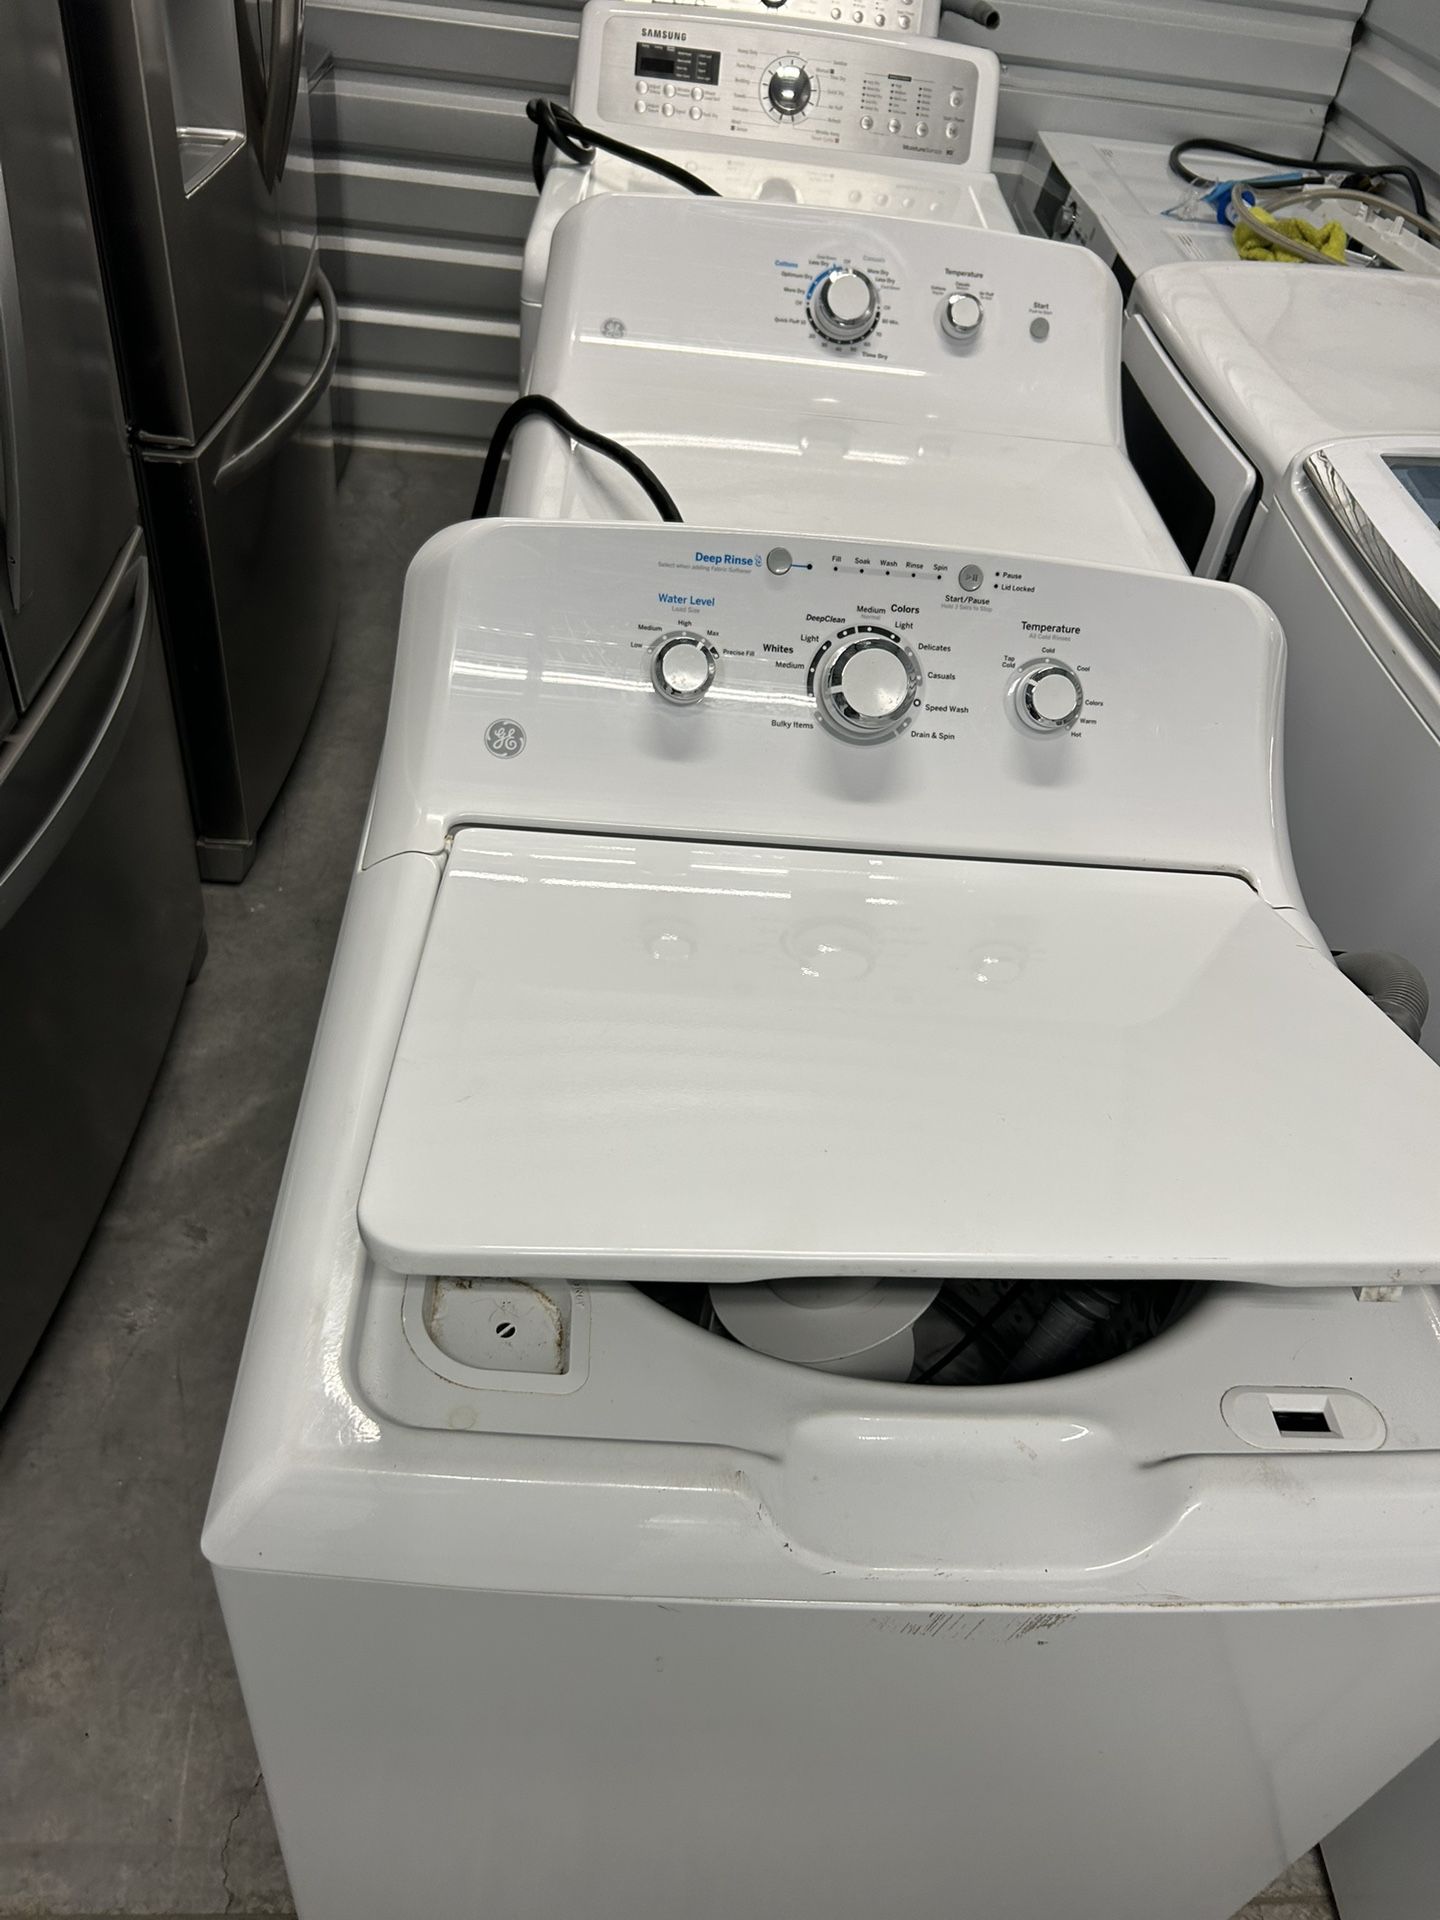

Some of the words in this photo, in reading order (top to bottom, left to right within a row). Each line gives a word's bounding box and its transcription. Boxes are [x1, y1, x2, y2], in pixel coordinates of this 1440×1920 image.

[641, 27, 687, 42] SAMSUNG
[774, 259, 799, 268] Cottons
[945, 267, 984, 279] Temperature
[1033, 301, 1050, 310] Start
[862, 351, 877, 359] Time
[877, 353, 889, 361] Dry
[695, 552, 722, 565] Deep
[724, 554, 754, 566] Rinse
[832, 555, 842, 563] Fill
[854, 557, 871, 565] Soak
[880, 559, 898, 568] Wash
[905, 562, 924, 570] Rinse
[933, 563, 948, 573] Spin
[1002, 572, 1022, 580] Pause
[1001, 583, 1012, 592] Lid
[1013, 584, 1035, 593] Locked
[658, 593, 688, 605] Water
[690, 595, 715, 607] Level
[945, 594, 990, 606] Start/Pause
[856, 605, 886, 615] Medium
[891, 603, 920, 615] Colors
[678, 619, 692, 628] High
[806, 613, 846, 624] DeepClean
[638, 624, 663, 632] Medium
[895, 620, 914, 630] Light
[1021, 620, 1081, 635] Temperature
[707, 629, 720, 637] Max
[800, 633, 819, 643] Light
[762, 643, 794, 654] Whites
[918, 642, 952, 652] Delicates
[1041, 646, 1056, 654] Cold
[722, 648, 746, 656] Precise
[745, 649, 755, 657] Fill
[1003, 655, 1016, 663] Tap
[775, 660, 805, 670] Medium
[927, 671, 956, 681] Casuals
[1084, 699, 1104, 707] Colors
[925, 704, 948, 715] Speed
[948, 705, 970, 714] Wash
[771, 719, 792, 730] Bulky
[792, 721, 814, 730] Items
[910, 730, 932, 739] Drain
[932, 731, 939, 739] &
[938, 732, 956, 741] Spin
